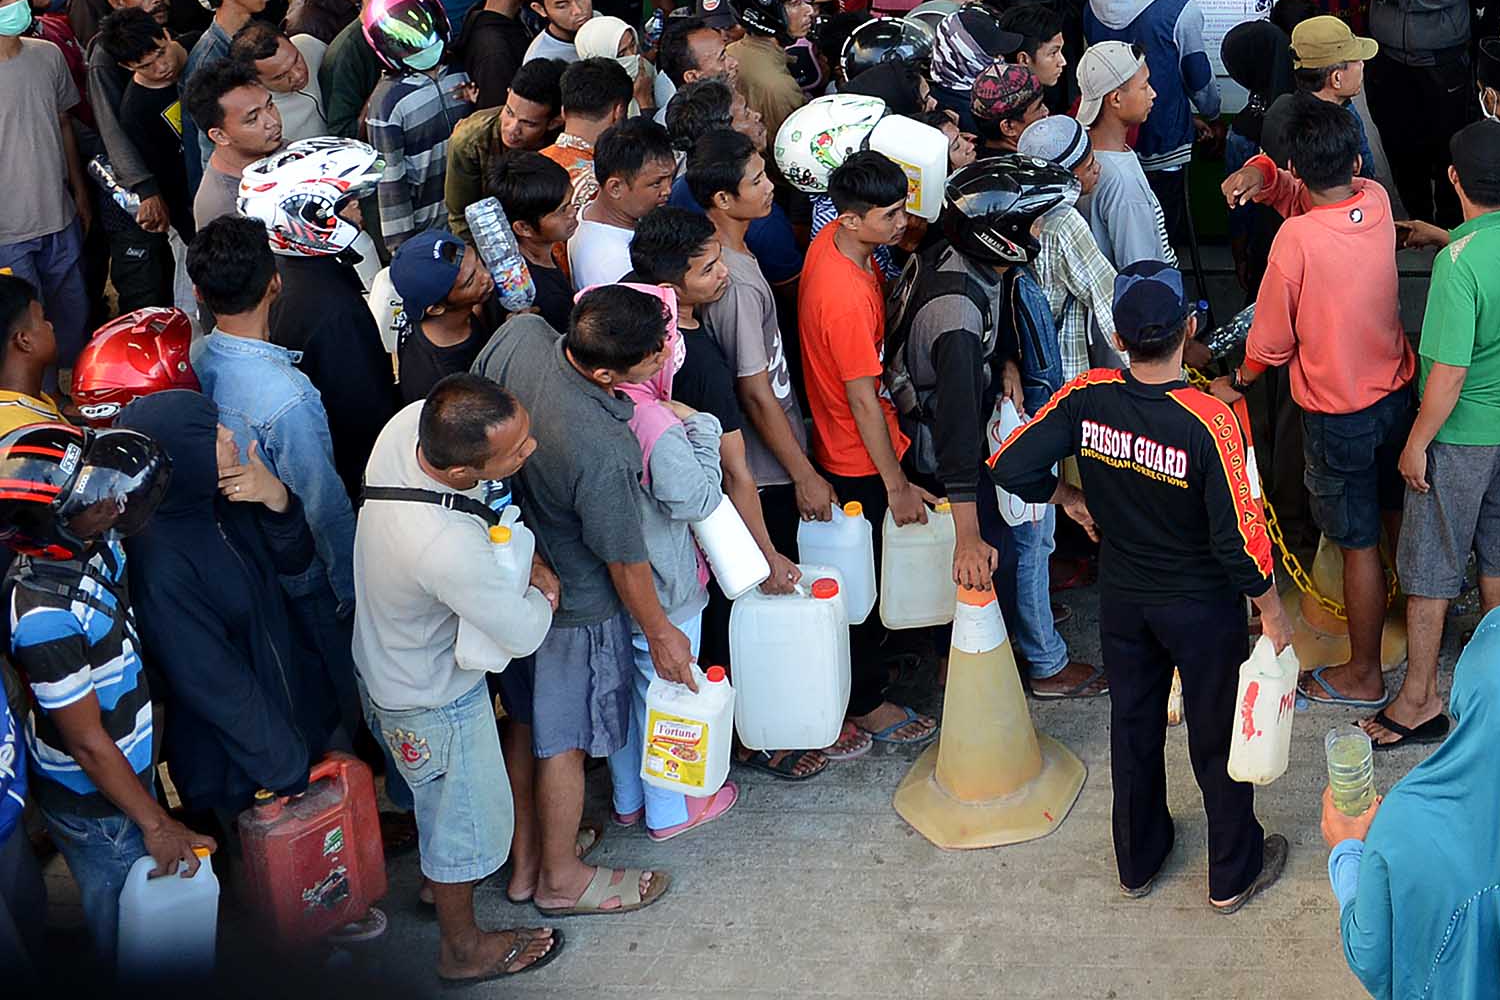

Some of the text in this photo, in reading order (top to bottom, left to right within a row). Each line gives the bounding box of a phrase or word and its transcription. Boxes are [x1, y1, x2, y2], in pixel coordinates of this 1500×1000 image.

[980, 232, 1006, 252] YAMAHA
[1080, 419, 1188, 479] PRISON GUARD
[1131, 461, 1190, 489] CORRECTIONS
[658, 724, 697, 739] Fortune
